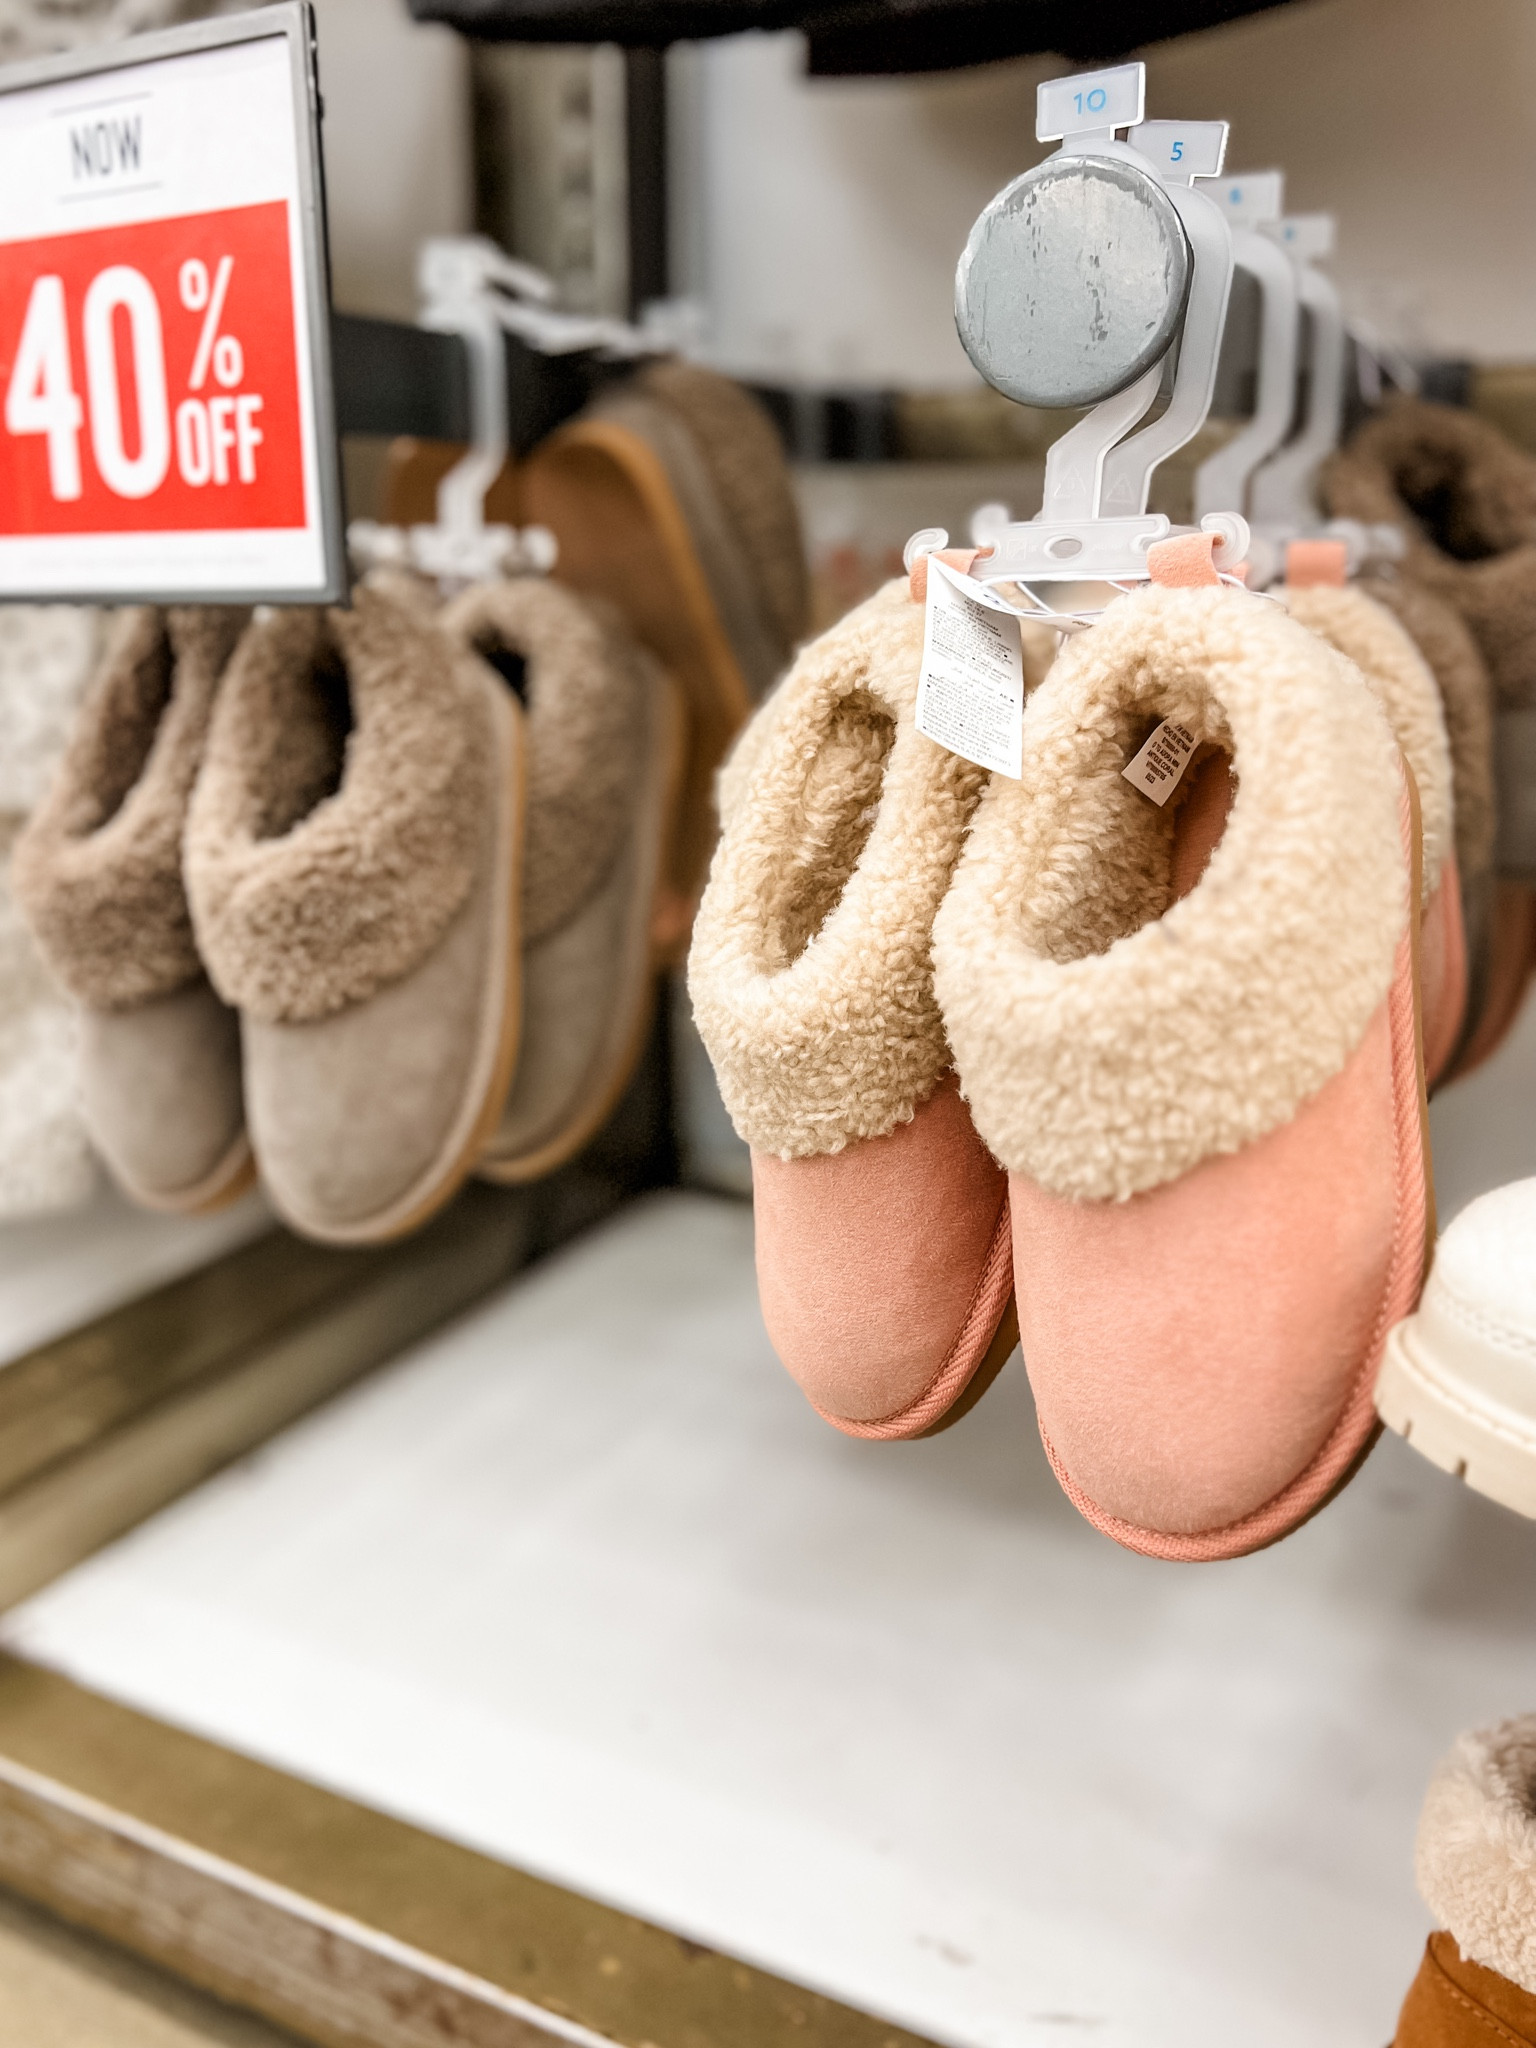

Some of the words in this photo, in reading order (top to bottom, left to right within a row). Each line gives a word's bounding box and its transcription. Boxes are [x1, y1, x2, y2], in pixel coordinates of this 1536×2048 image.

[1073, 88, 1107, 115] 10
[70, 114, 144, 181] NOW
[1170, 141, 1184, 162] 5
[7, 264, 171, 501] 40
[175, 394, 263, 486] OFF
